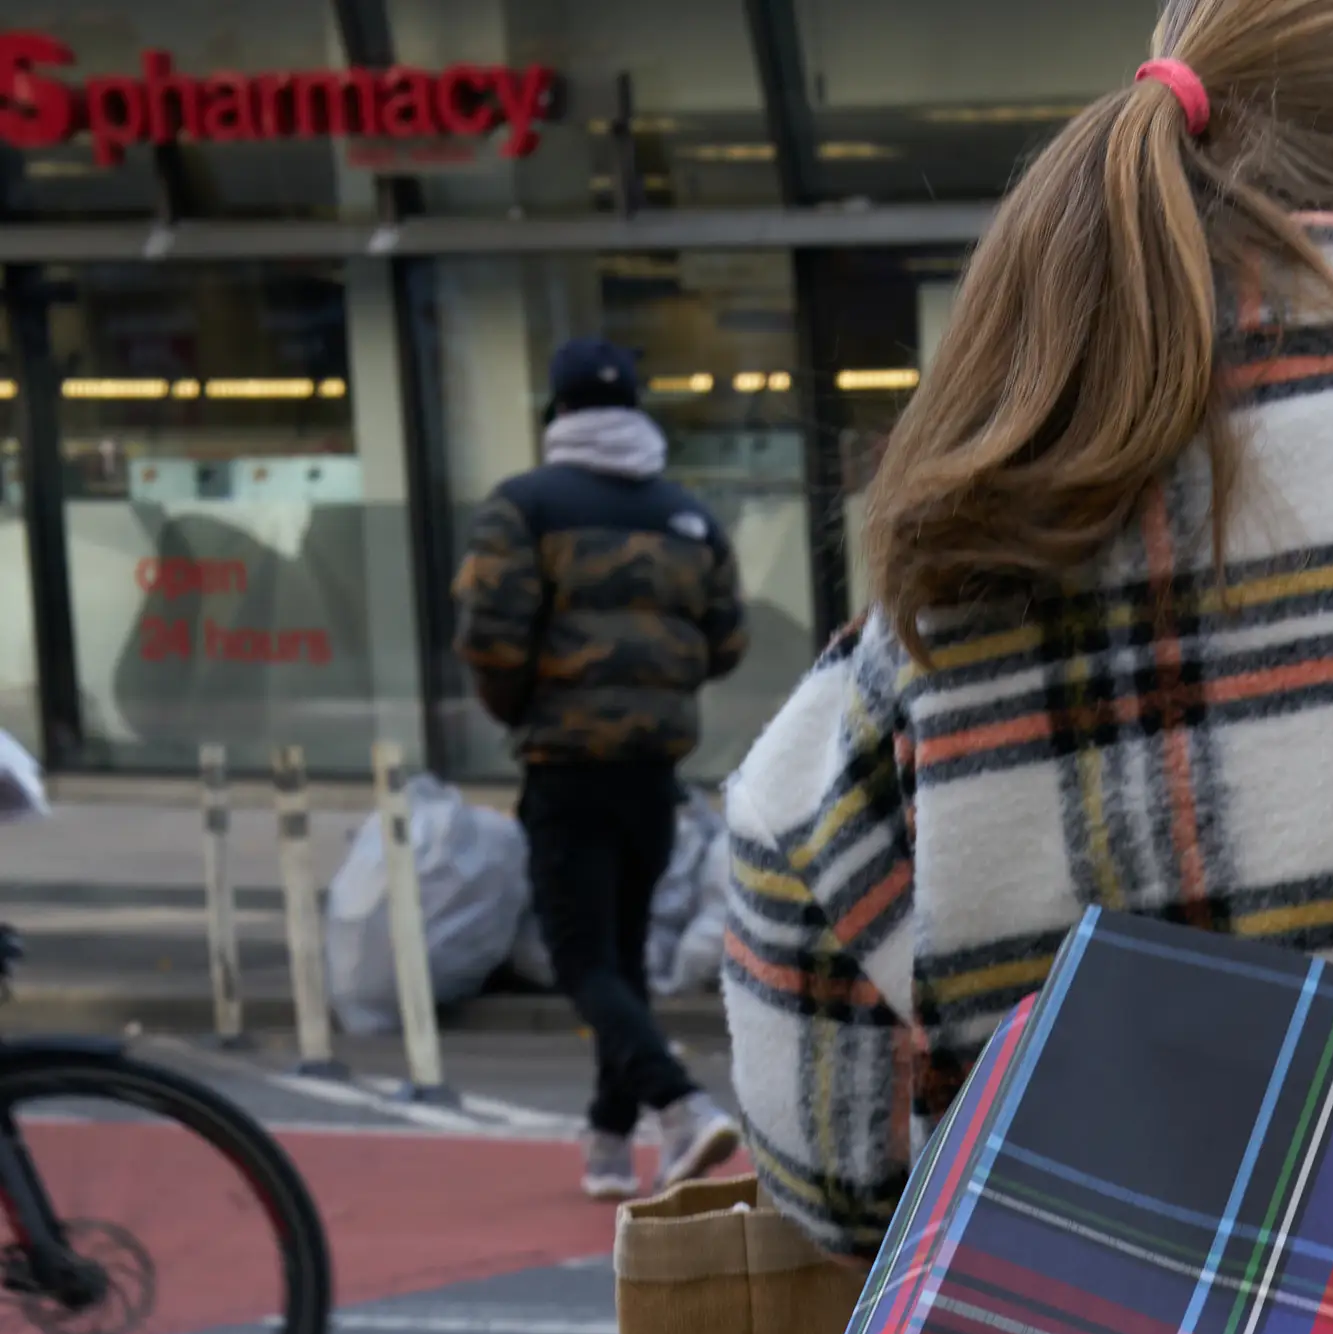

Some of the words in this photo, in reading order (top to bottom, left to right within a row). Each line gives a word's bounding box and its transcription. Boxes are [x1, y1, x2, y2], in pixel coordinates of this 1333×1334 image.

[86, 47, 556, 168] pharmacy
[134, 556, 248, 602] open
[140, 614, 192, 663] 24
[203, 615, 333, 668] hours
